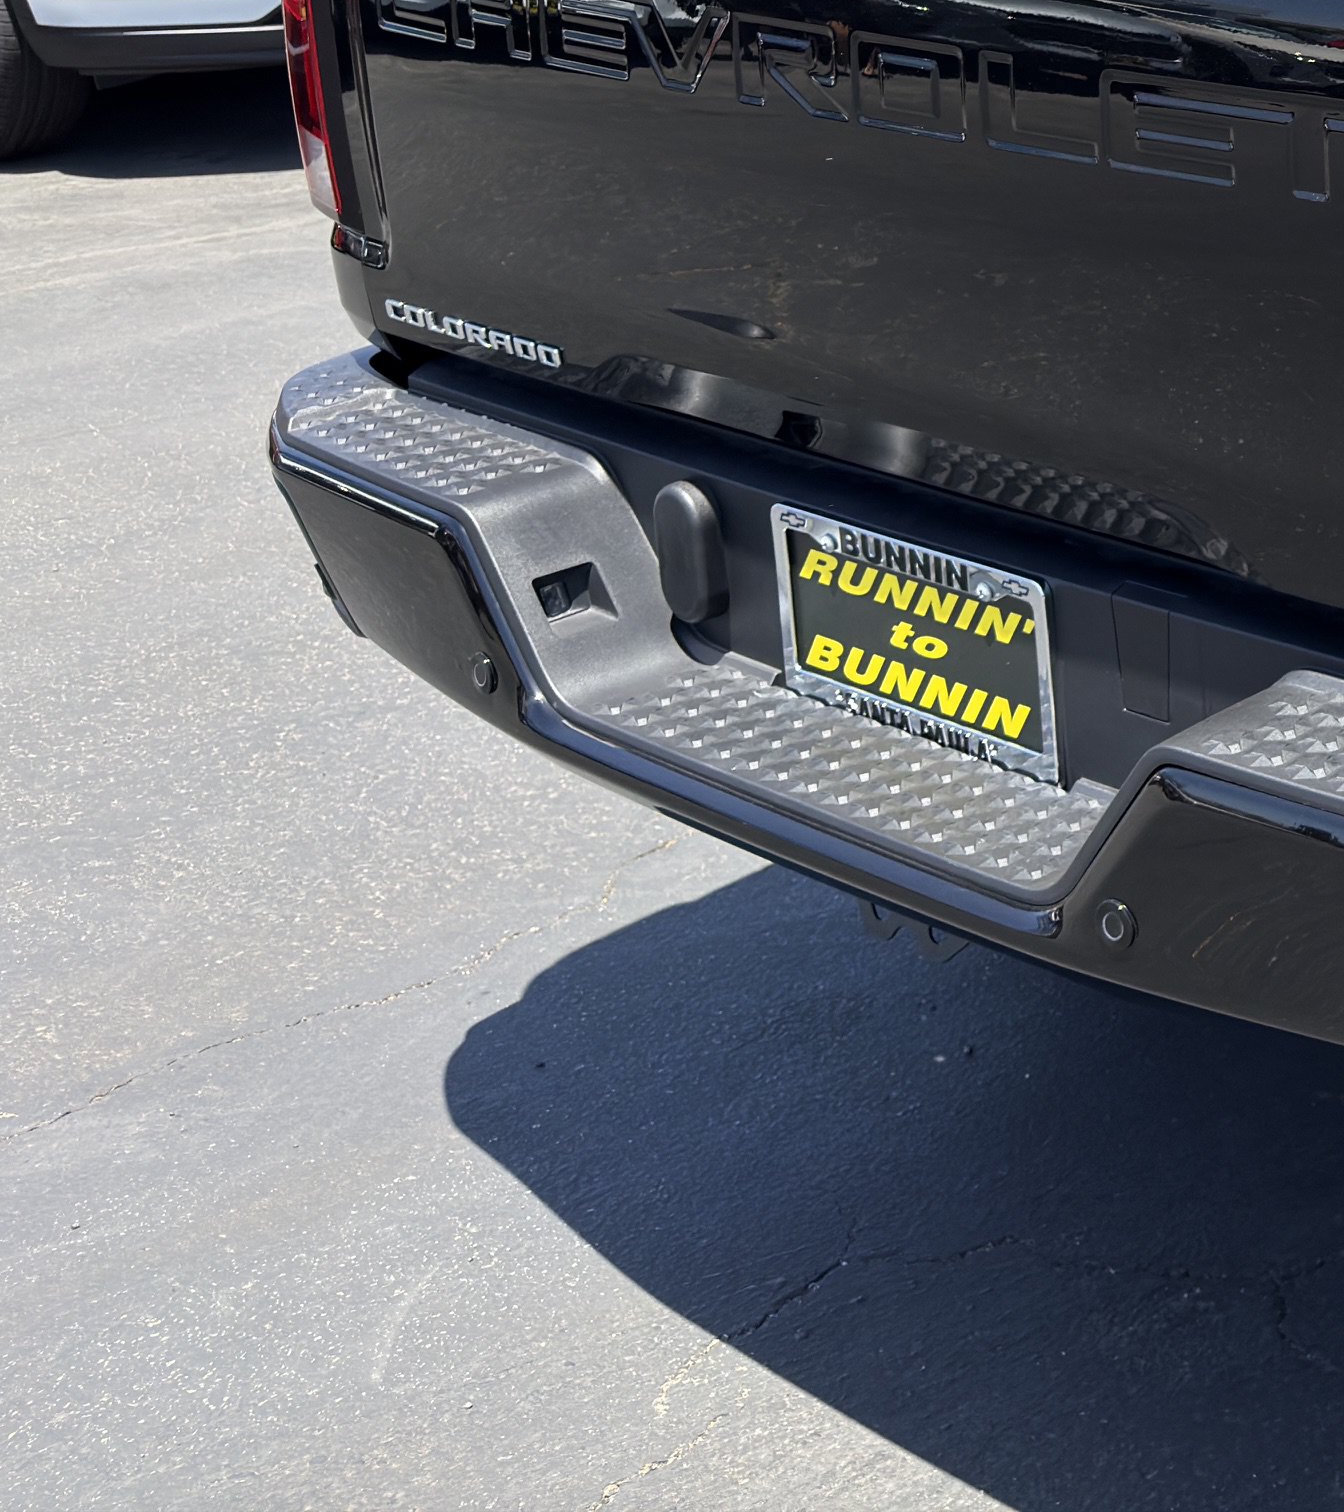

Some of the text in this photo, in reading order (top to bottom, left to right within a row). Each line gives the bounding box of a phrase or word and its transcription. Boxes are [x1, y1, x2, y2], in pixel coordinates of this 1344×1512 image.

[384, 298, 565, 368] COLORADO
[838, 526, 970, 593] BUNNIN
[798, 548, 1036, 646] RUNNIN'
[890, 621, 949, 659] to
[805, 634, 1032, 740] BUNNIN
